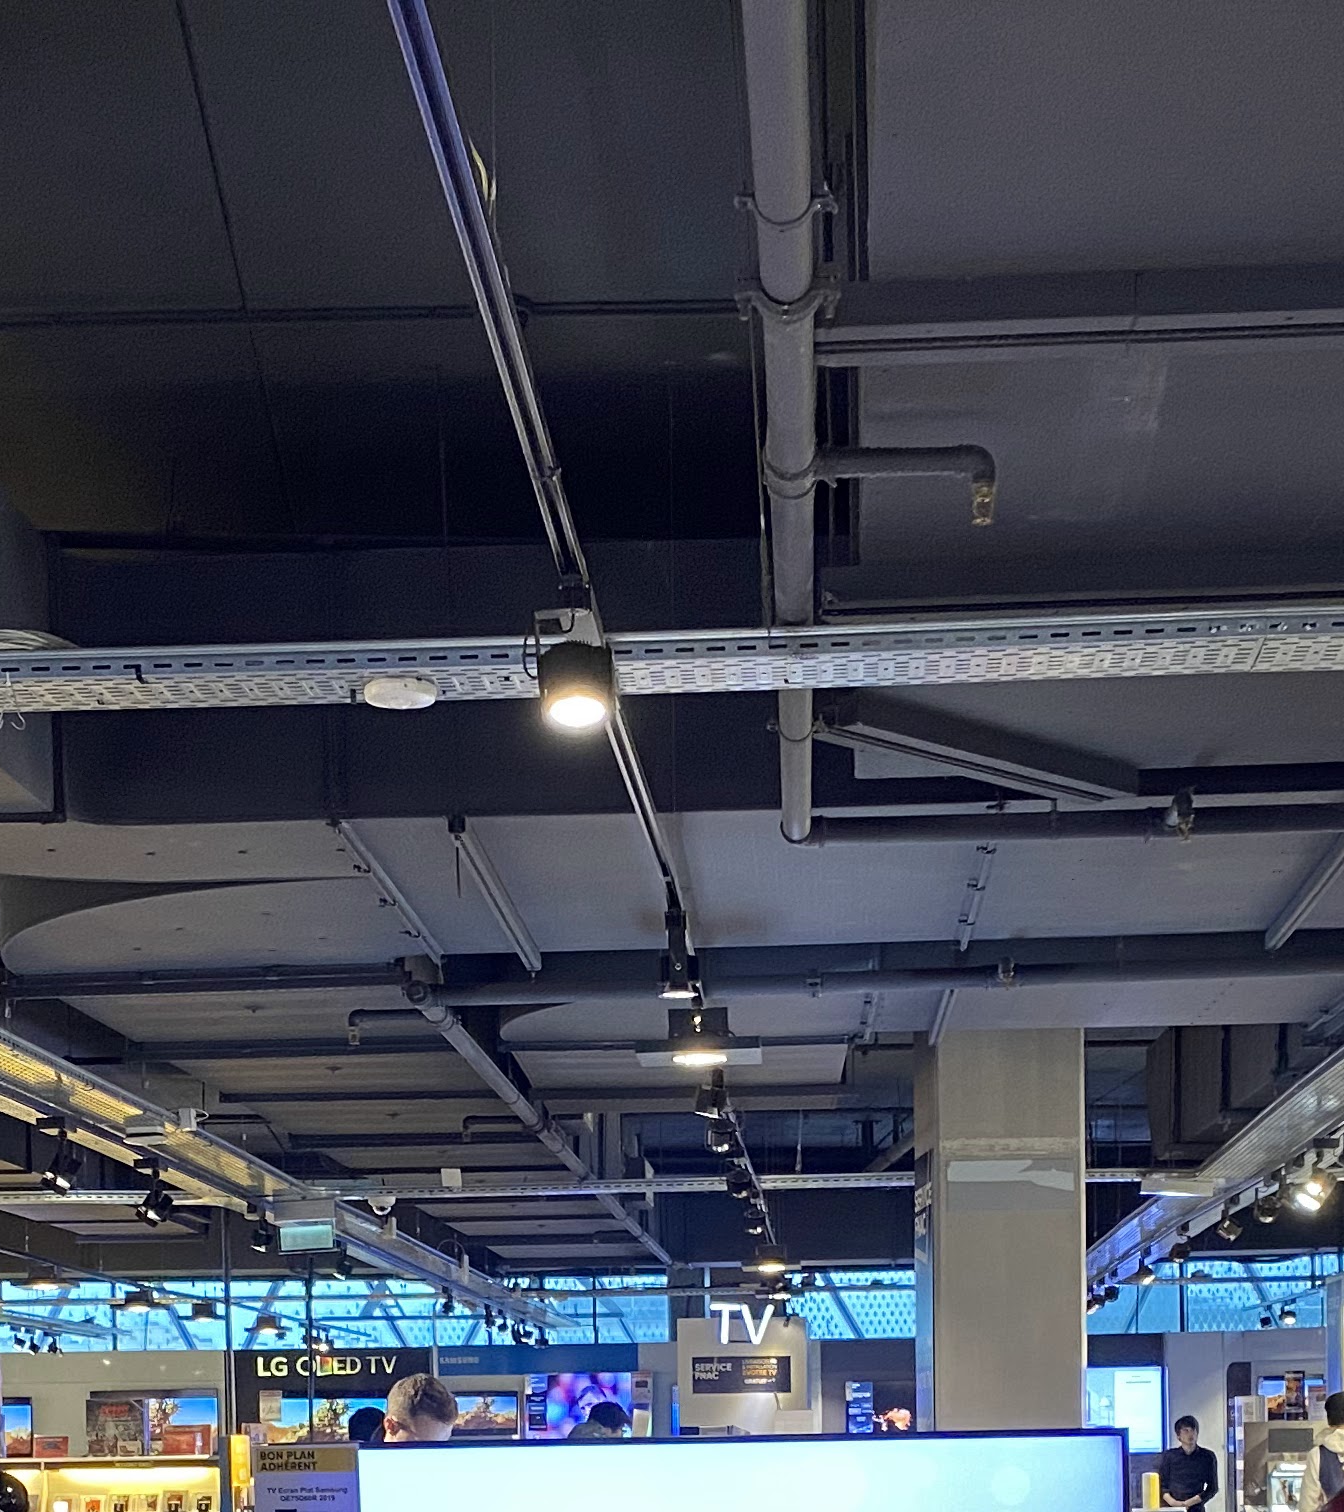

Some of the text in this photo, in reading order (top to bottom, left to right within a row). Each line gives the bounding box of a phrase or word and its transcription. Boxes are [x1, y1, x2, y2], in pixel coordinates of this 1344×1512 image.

[710, 1302, 775, 1345] TV
[439, 1356, 479, 1365] SAMSUNG
[256, 1355, 397, 1377] LG OLED TV
[694, 1363, 732, 1372] SERVICE
[694, 1371, 719, 1380] FNAC
[259, 1450, 316, 1461] BON PLAN
[260, 1460, 318, 1472] ADHÉRENT
[315, 1487, 348, 1496] Samsung
